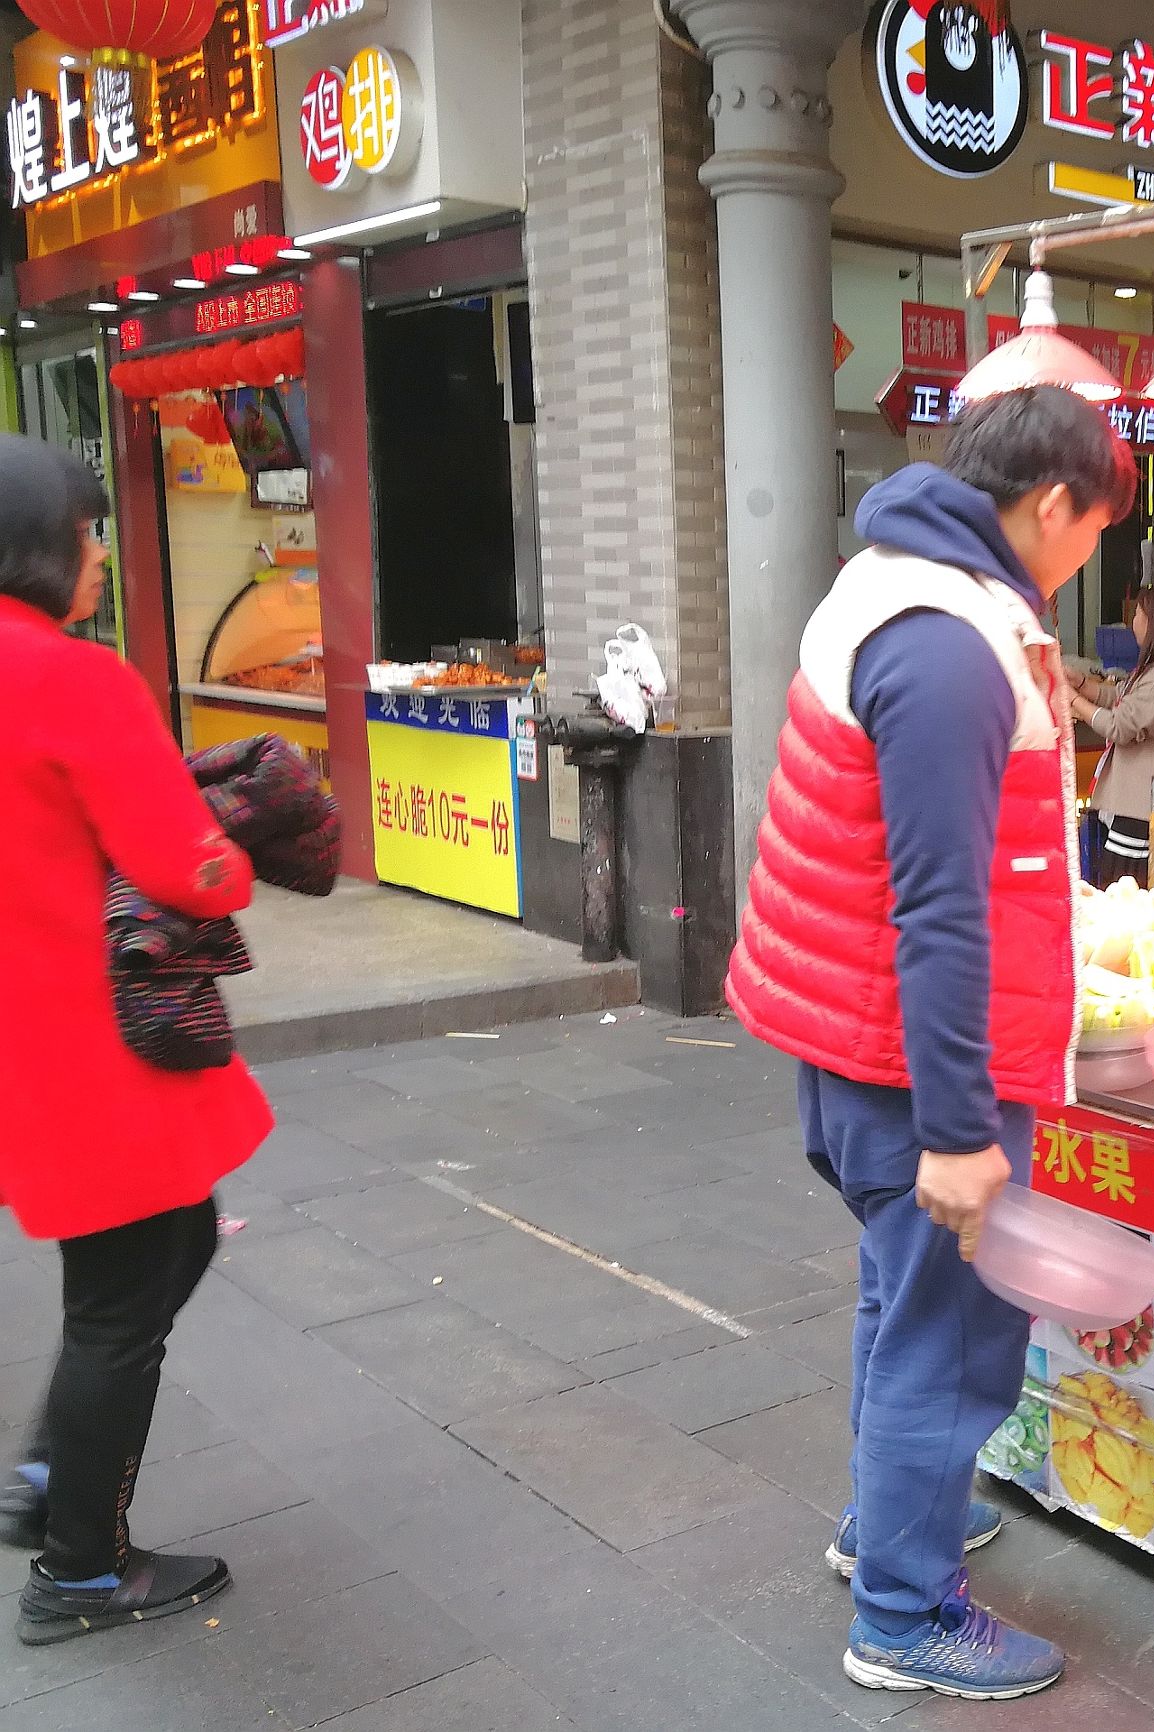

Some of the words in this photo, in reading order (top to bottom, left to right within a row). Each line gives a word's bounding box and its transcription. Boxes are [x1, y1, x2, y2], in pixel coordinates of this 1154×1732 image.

[6, 66, 139, 210] 煌上煌
[301, 52, 398, 170] 鸡排
[376, 776, 510, 856] 连心脆10元一份
[1031, 1118, 1136, 1204] 水果
